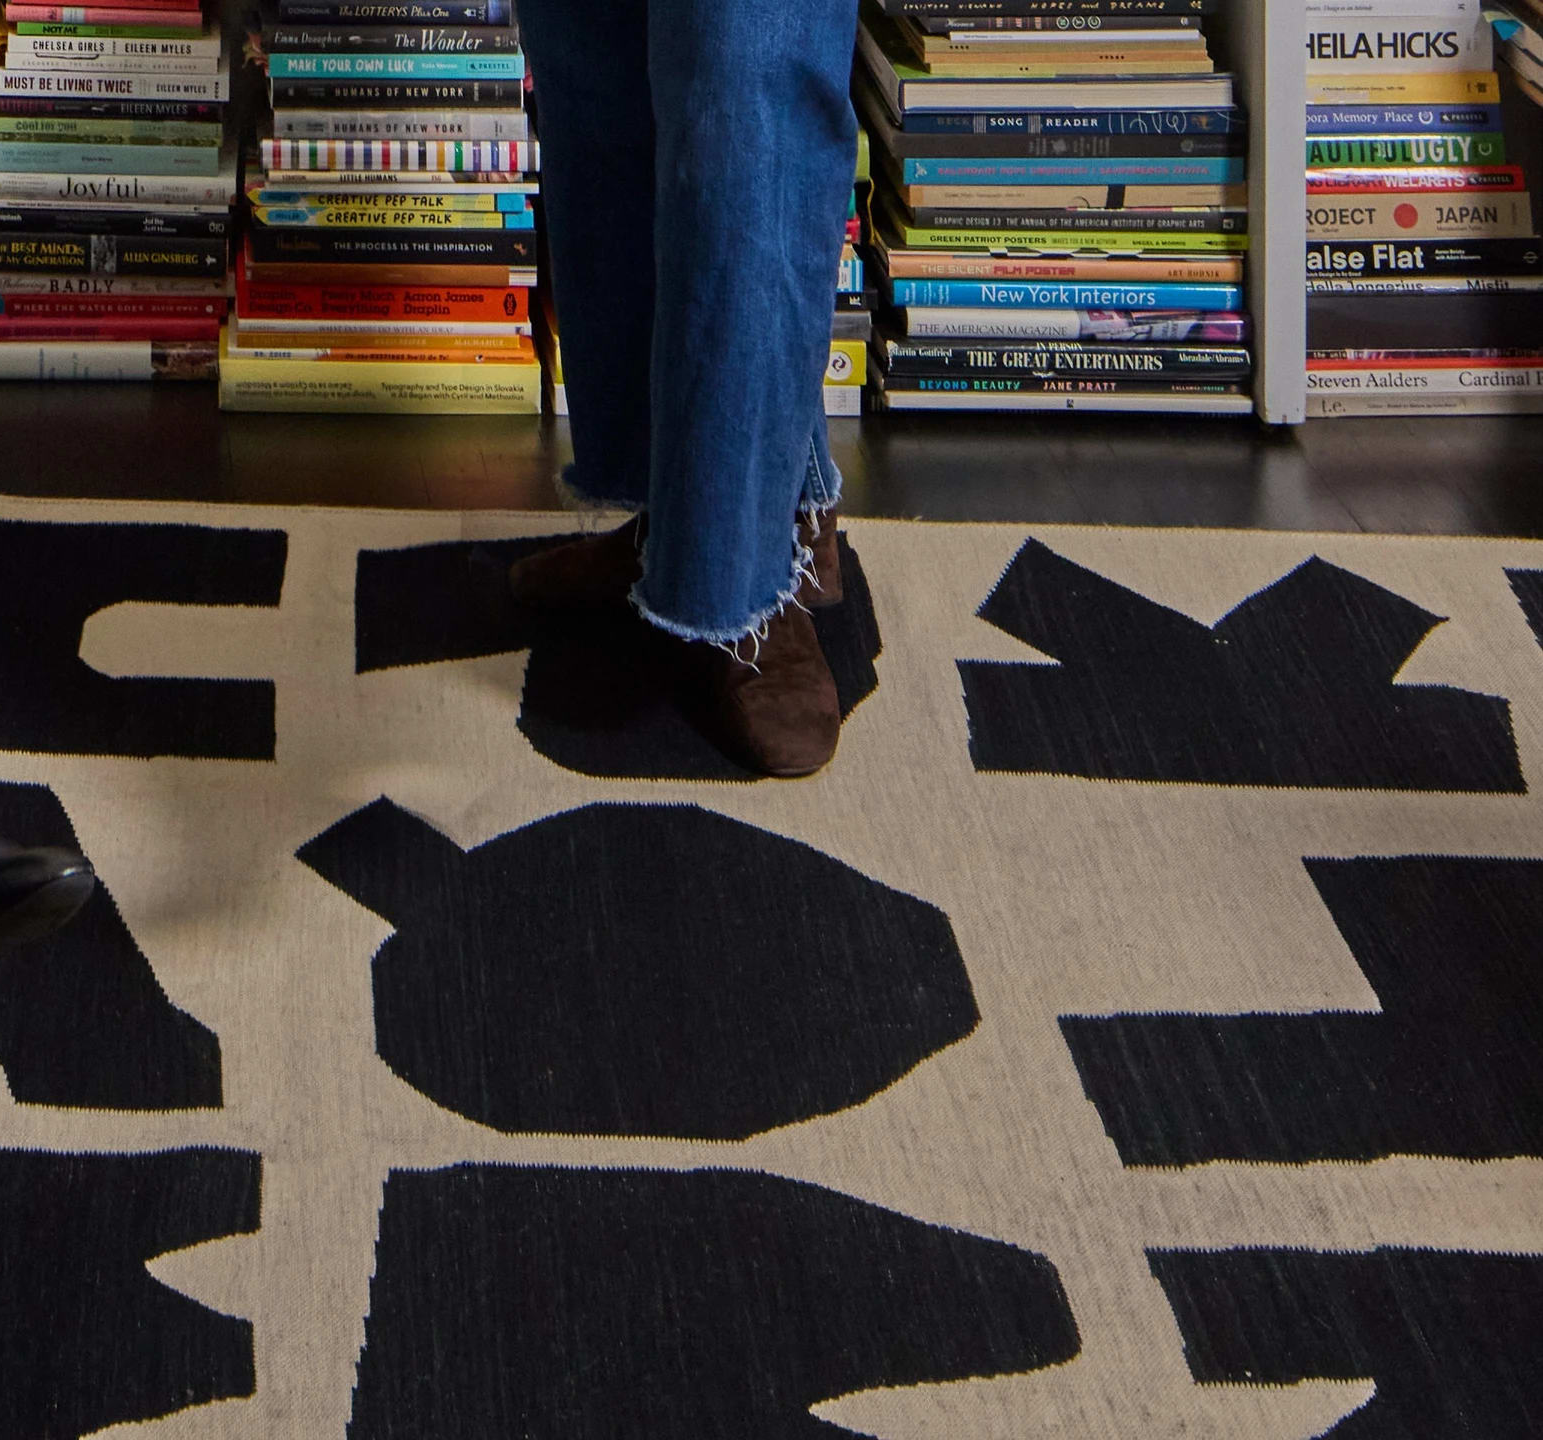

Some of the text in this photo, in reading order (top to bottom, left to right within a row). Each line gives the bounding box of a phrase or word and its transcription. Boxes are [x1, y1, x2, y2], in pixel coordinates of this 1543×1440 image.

[33, 40, 105, 52] CHELSEA GIRLS
[1378, 31, 1458, 59] HICKS
[4, 79, 35, 90] MUST
[39, 79, 52, 90] BE
[58, 80, 92, 92] LIVING
[98, 80, 133, 93] TWICE
[59, 176, 141, 201] Joyful
[1435, 206, 1498, 224] JAPAN
[981, 285, 1156, 305] New York Interiors
[967, 351, 1162, 370] THE GREAT ENTERTAINERS
